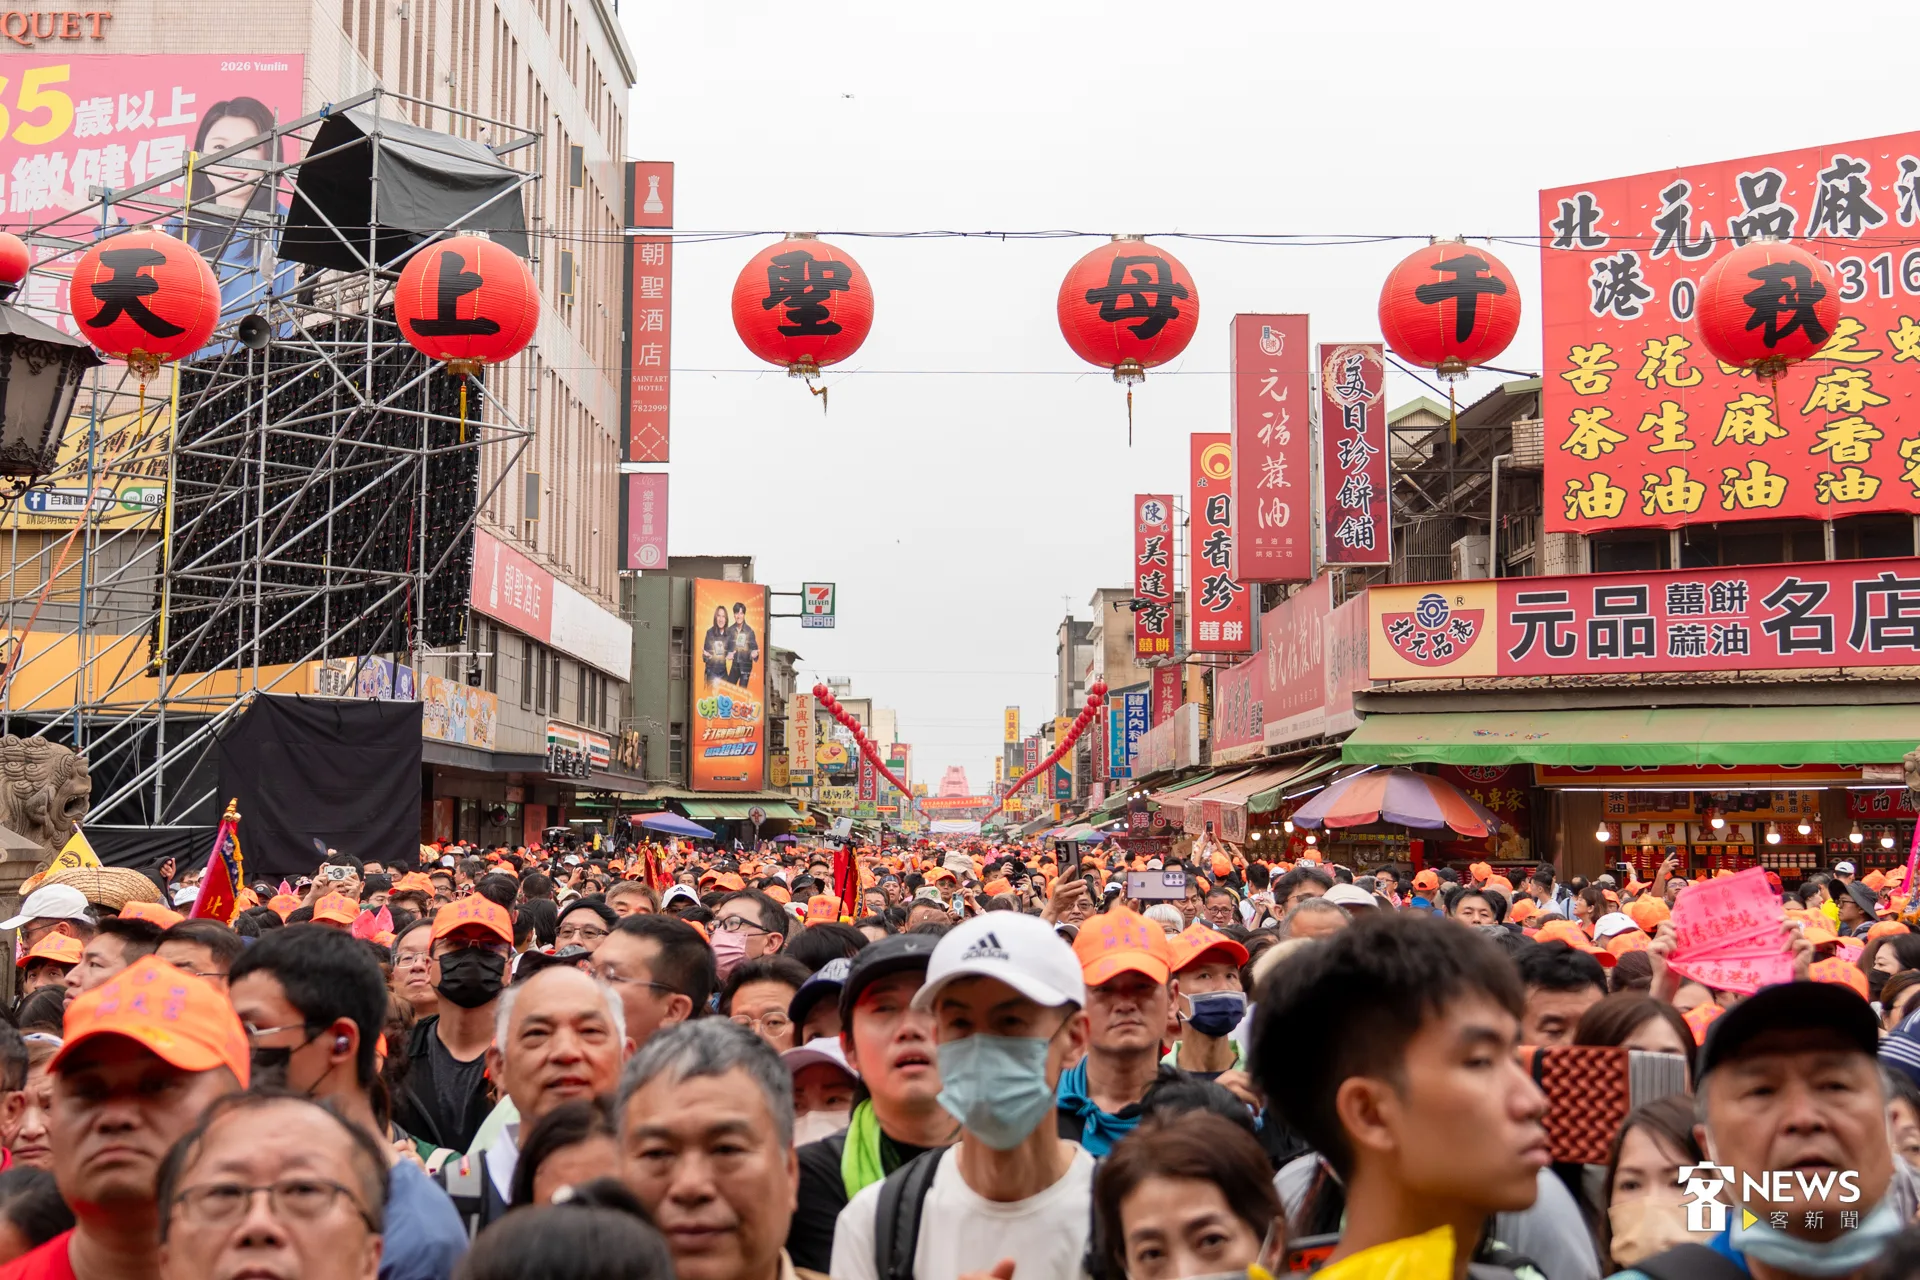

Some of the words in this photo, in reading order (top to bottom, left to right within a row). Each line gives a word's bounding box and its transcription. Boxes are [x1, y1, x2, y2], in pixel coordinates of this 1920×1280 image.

[0, 10, 112, 46] QUET
[220, 62, 251, 72] 2026
[253, 62, 288, 72] Yunlin
[0, 135, 187, 214] 繳健保
[86, 248, 186, 338] 天
[409, 250, 501, 336] 上
[639, 243, 664, 366] 朝聖酒店
[761, 250, 853, 337] 聖
[1085, 256, 1189, 340] 母
[1415, 254, 1507, 343] 千
[1743, 260, 1829, 348] 秋
[1560, 342, 1629, 521] 苦茶油
[1635, 333, 1707, 516] 花生油
[1712, 356, 1790, 511] 麻油
[1145, 502, 1163, 522] 陳
[1200, 493, 1244, 613] 日香珍
[503, 562, 542, 622] 朝聖酒店
[809, 587, 829, 614] 7
[1138, 535, 1171, 634] 美達香
[1507, 583, 1657, 662] 元品
[1759, 570, 1920, 656] 名店
[1198, 621, 1243, 642] 囍餅
[795, 695, 809, 769] 宜興百貨行
